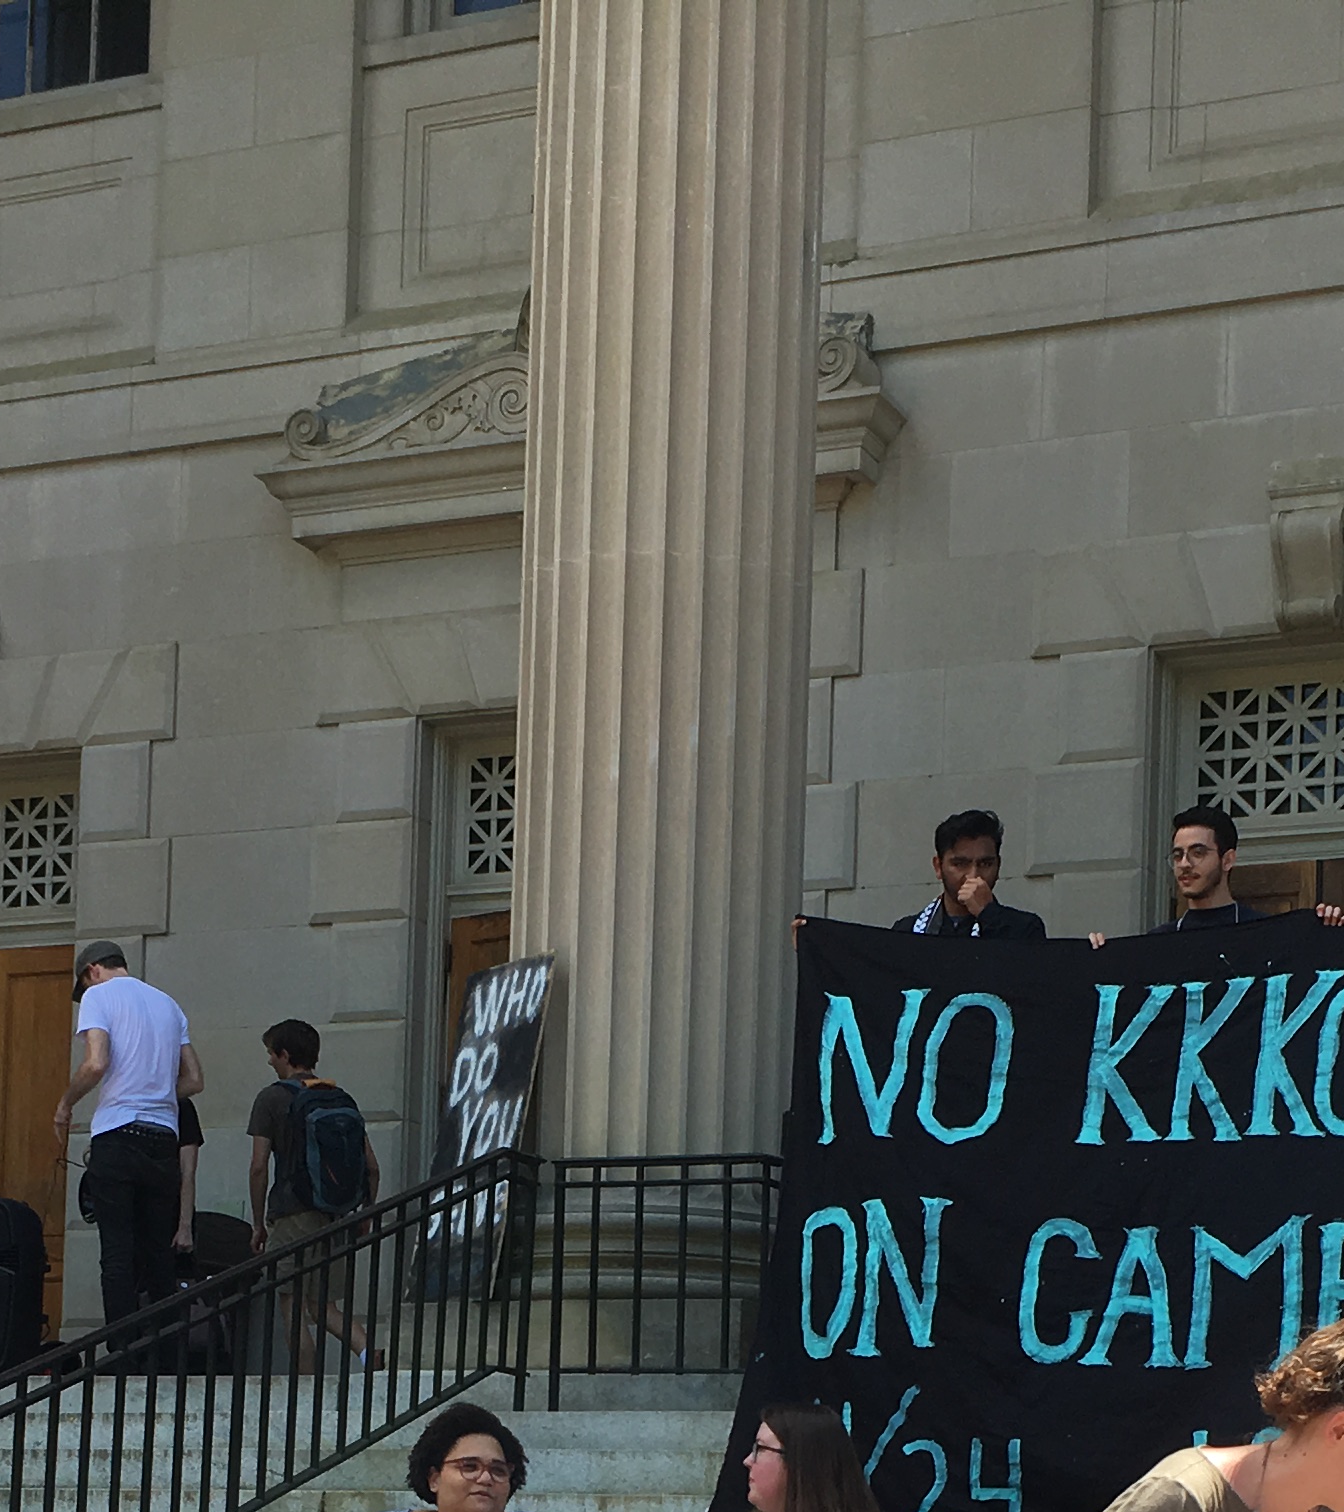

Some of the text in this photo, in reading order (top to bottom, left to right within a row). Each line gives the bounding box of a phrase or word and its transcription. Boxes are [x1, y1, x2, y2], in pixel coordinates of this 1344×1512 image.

[473, 964, 547, 1037] WHO
[449, 1043, 499, 1107] DO
[817, 987, 1014, 1146] NO
[457, 1094, 524, 1167] YOU
[801, 1197, 954, 1360] ON
